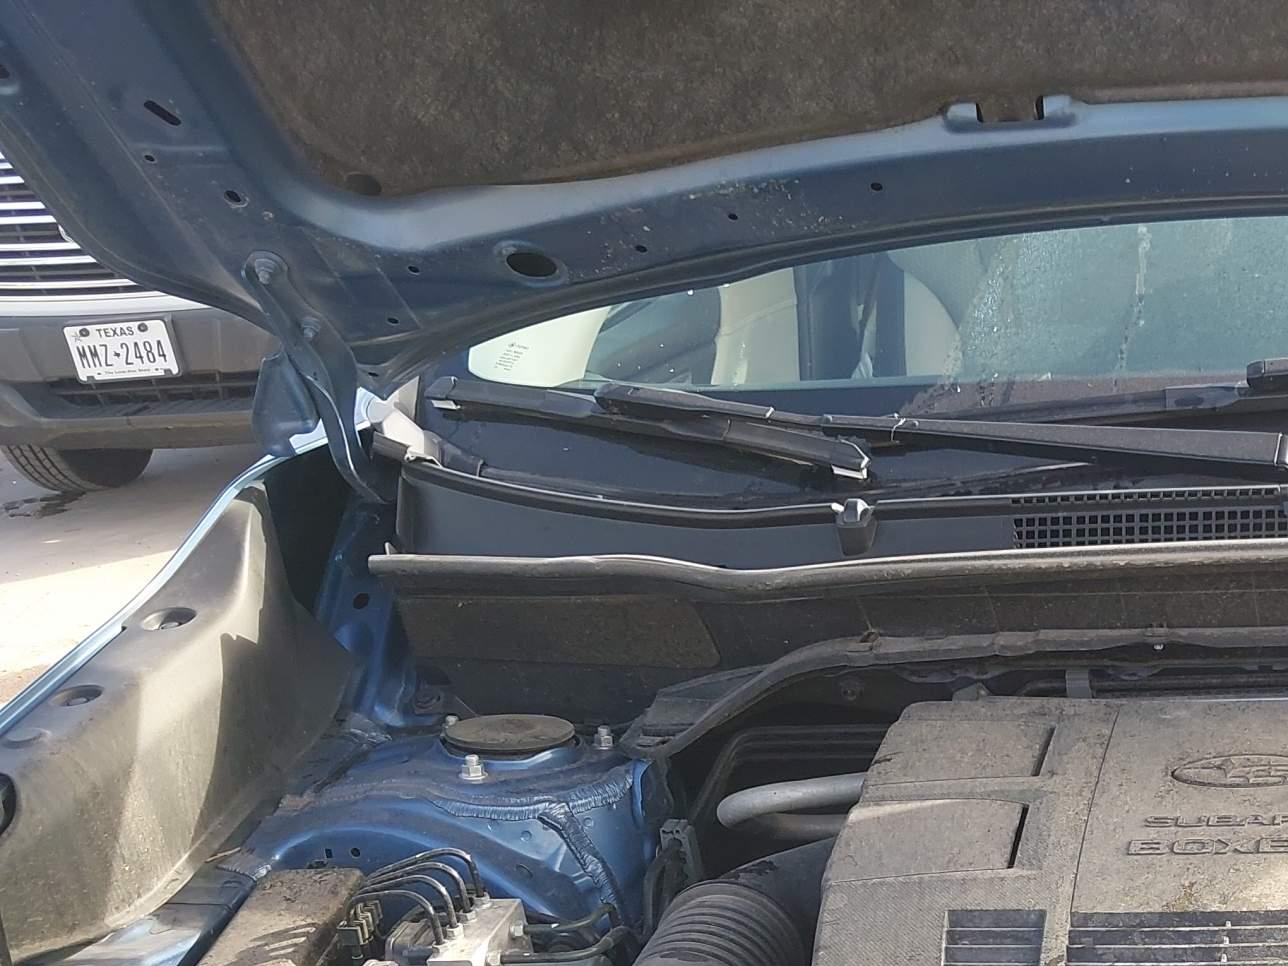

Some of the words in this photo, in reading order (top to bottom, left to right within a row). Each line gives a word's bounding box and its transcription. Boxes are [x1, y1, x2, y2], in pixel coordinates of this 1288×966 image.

[96, 326, 134, 338] TEXAS
[77, 344, 113, 368] MMZ
[120, 339, 167, 365] 2484
